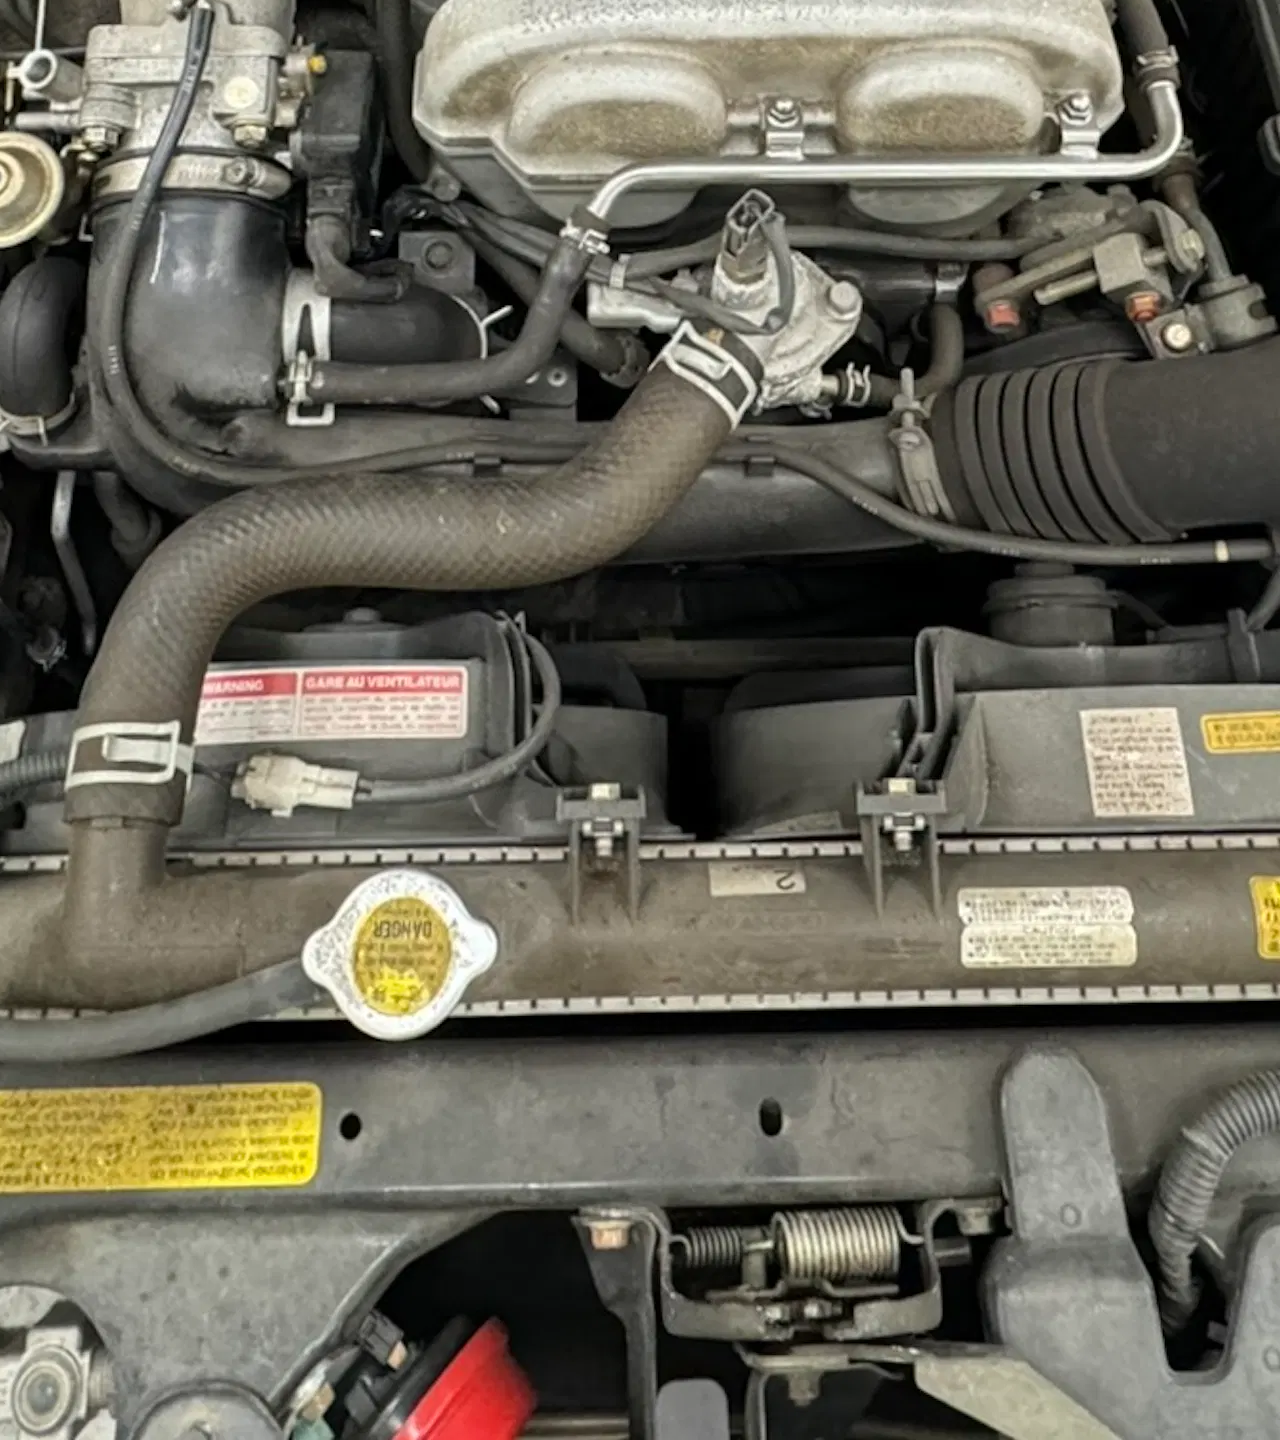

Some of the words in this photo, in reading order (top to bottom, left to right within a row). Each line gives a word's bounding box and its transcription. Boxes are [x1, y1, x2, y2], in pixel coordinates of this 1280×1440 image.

[306, 676, 343, 689] GARE
[346, 676, 365, 688] AU
[368, 675, 461, 688] VENTILATEUR
[373, 921, 432, 940] DANGER
